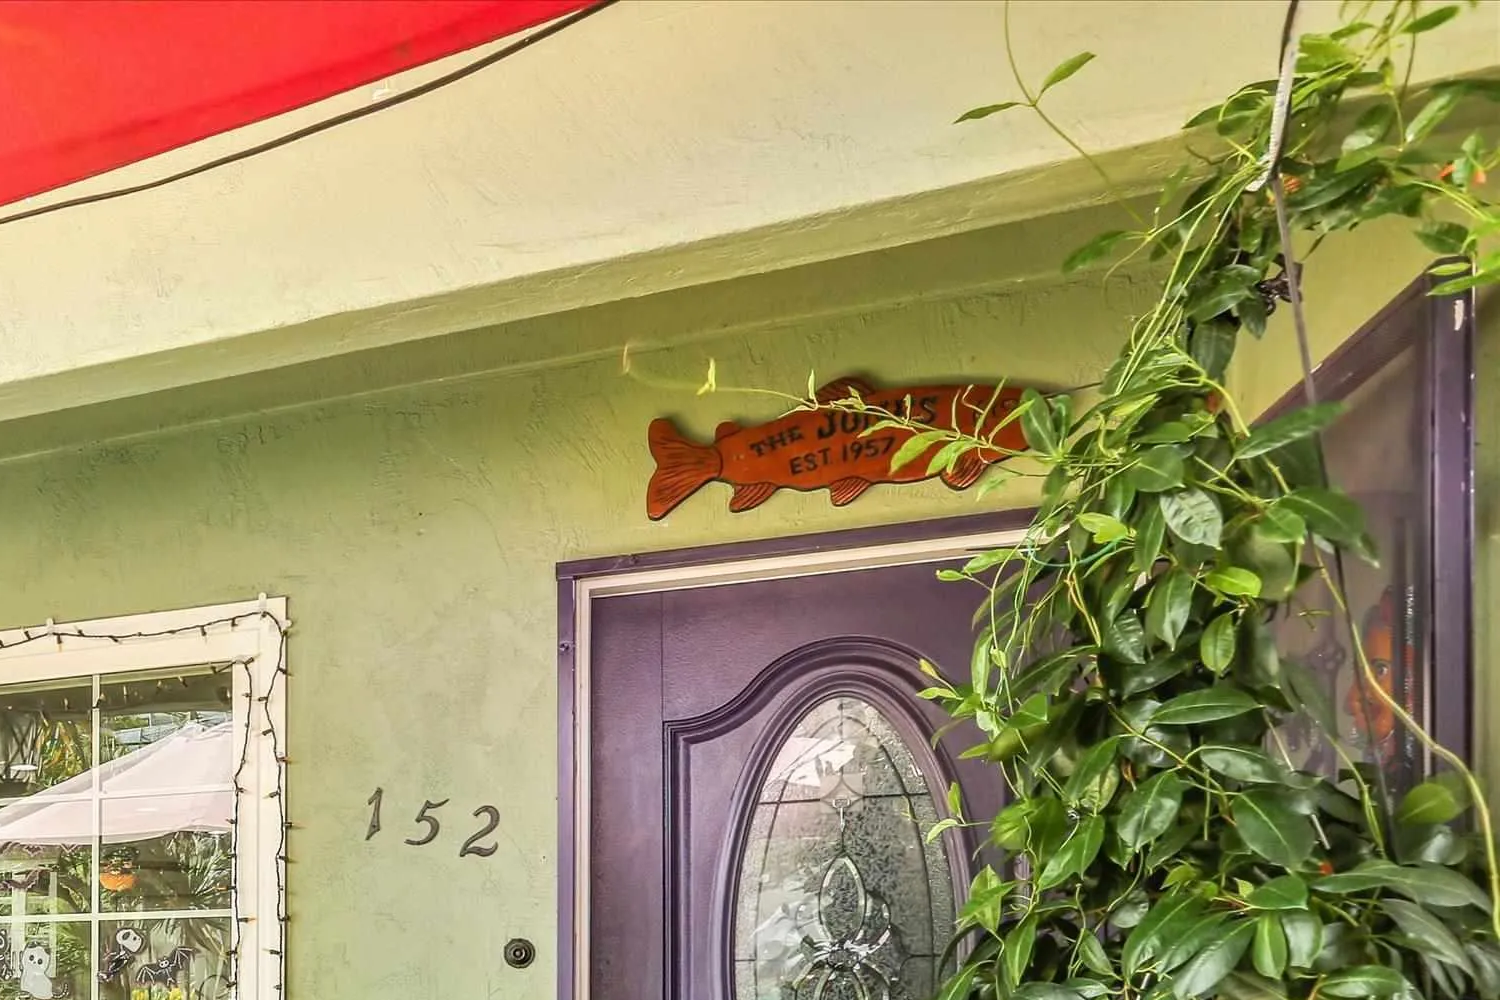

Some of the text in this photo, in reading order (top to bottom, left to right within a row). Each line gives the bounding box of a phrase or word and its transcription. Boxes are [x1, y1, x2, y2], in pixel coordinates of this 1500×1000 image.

[750, 426, 803, 457] THE
[841, 435, 897, 463] 1957
[365, 786, 500, 858] 152
